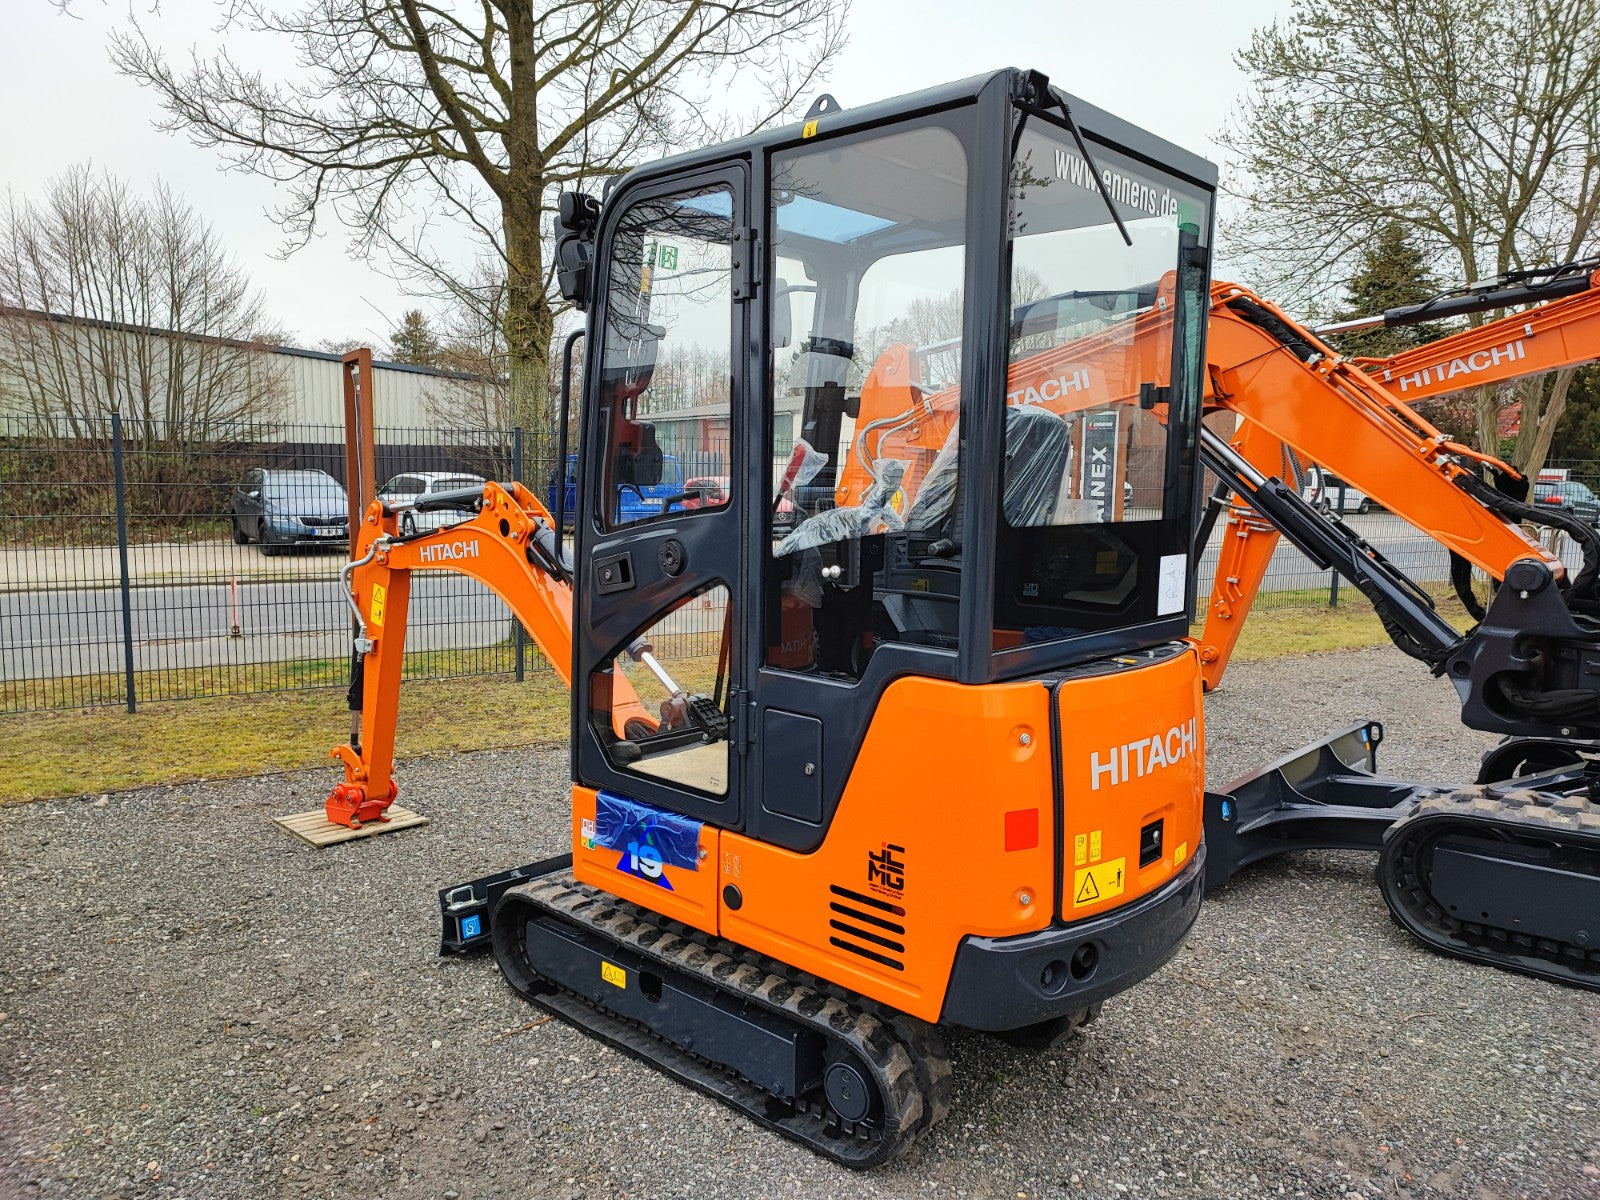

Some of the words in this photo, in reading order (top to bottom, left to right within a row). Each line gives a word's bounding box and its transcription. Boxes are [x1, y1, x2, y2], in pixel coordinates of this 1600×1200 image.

[1055, 149, 1178, 221] www.ennens.de
[1399, 340, 1526, 391] HITACHI
[1007, 368, 1090, 410] TACHI
[419, 539, 479, 563] HITACHI
[1090, 716, 1197, 791] HITACHI
[627, 841, 663, 882] 19
